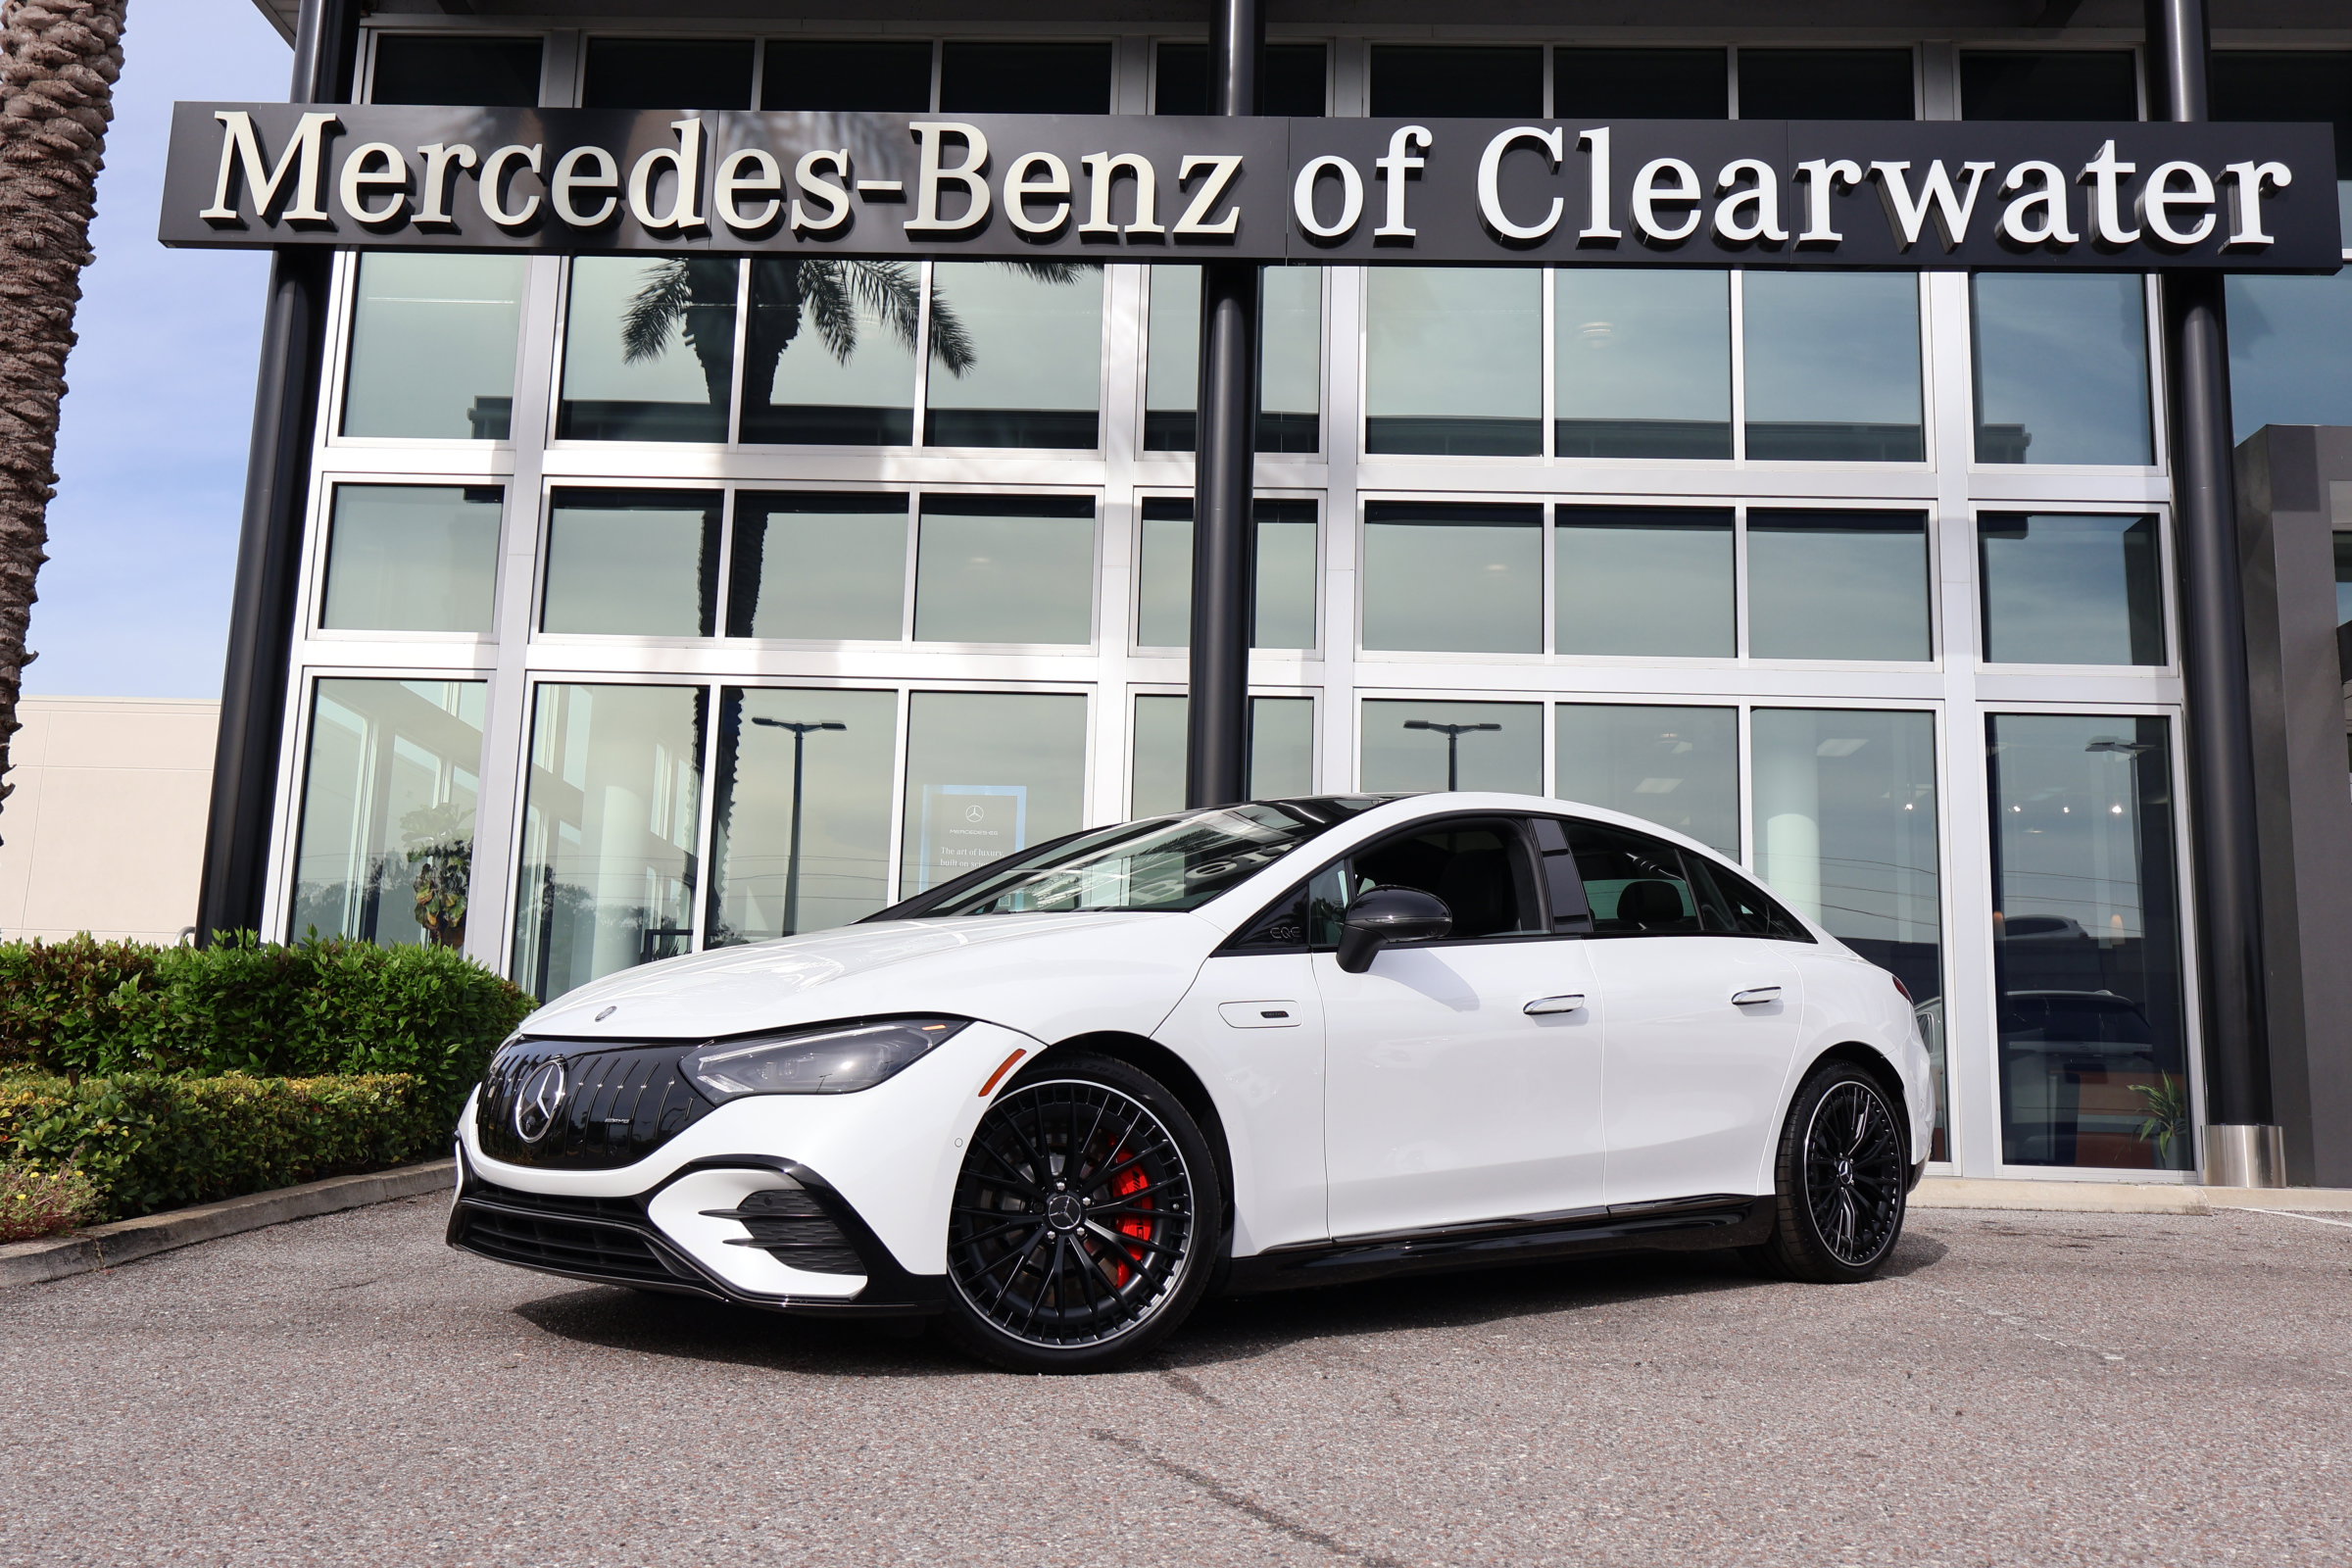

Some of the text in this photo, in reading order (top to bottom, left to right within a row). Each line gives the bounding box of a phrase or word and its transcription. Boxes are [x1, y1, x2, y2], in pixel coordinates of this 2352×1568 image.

[199, 110, 2292, 245] Mercedes-Benz of Clearwater
[941, 847, 956, 856] The
[969, 848, 978, 857] of
[1269, 926, 1301, 939] EQE
